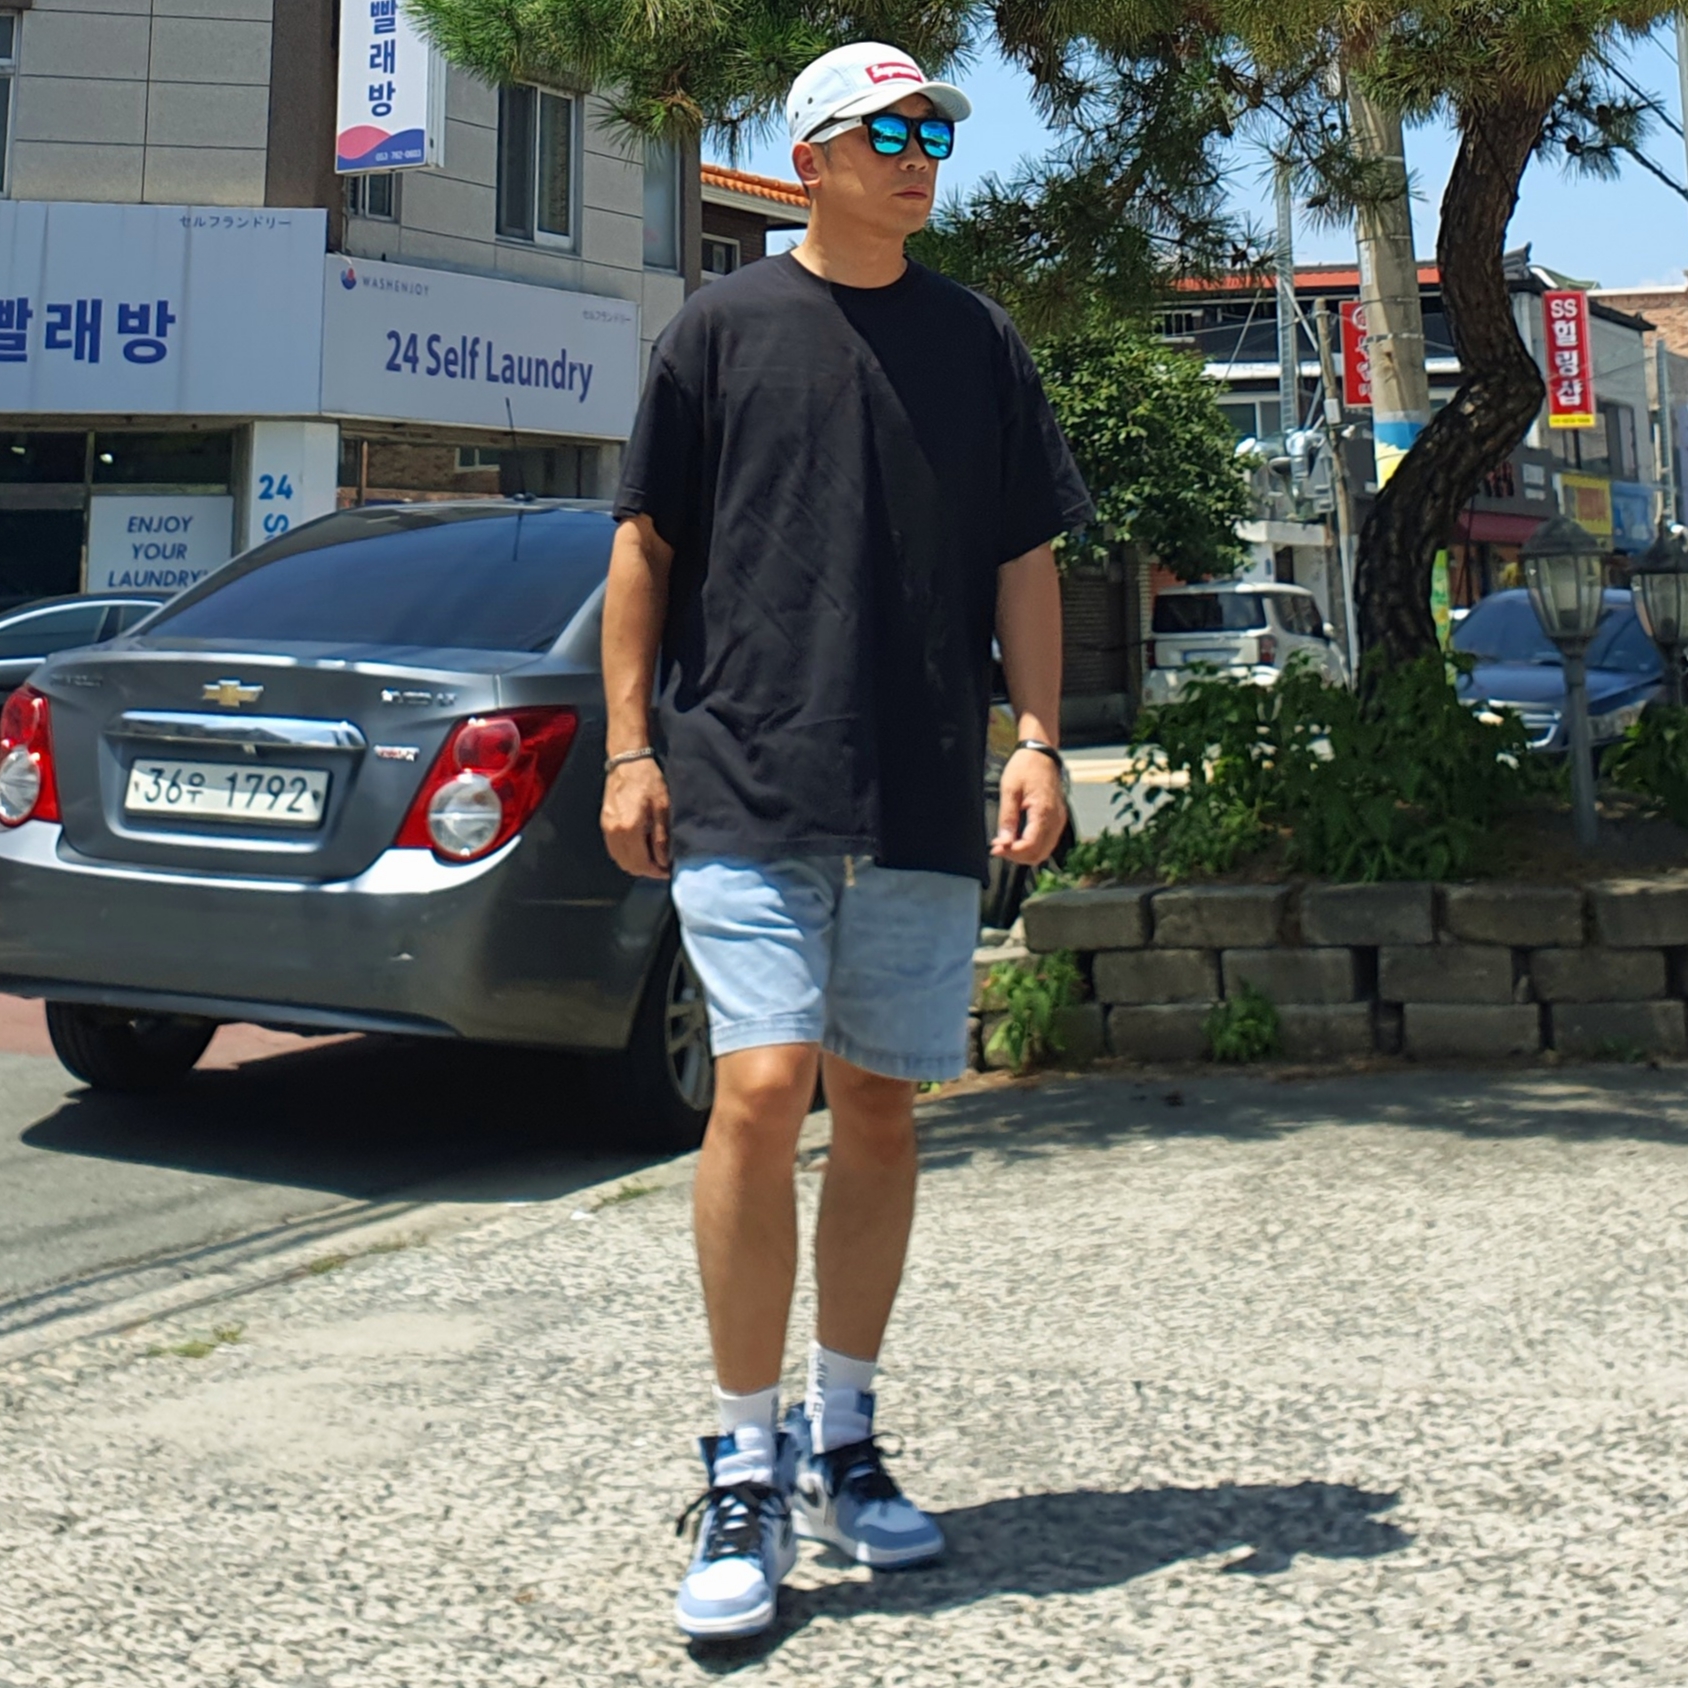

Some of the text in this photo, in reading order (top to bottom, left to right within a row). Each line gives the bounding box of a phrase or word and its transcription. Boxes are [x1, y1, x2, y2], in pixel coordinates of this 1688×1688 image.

[368, 0, 398, 118] 빨래방
[180, 215, 292, 230] セルフランドリー
[362, 276, 429, 296] WASHENJOY
[1551, 298, 1578, 318] SS
[385, 330, 593, 404] 24 Self Laundry
[258, 474, 293, 500] 24
[127, 516, 194, 533] ENJOY
[132, 543, 188, 560] YOUR
[225, 771, 308, 813] 1792
